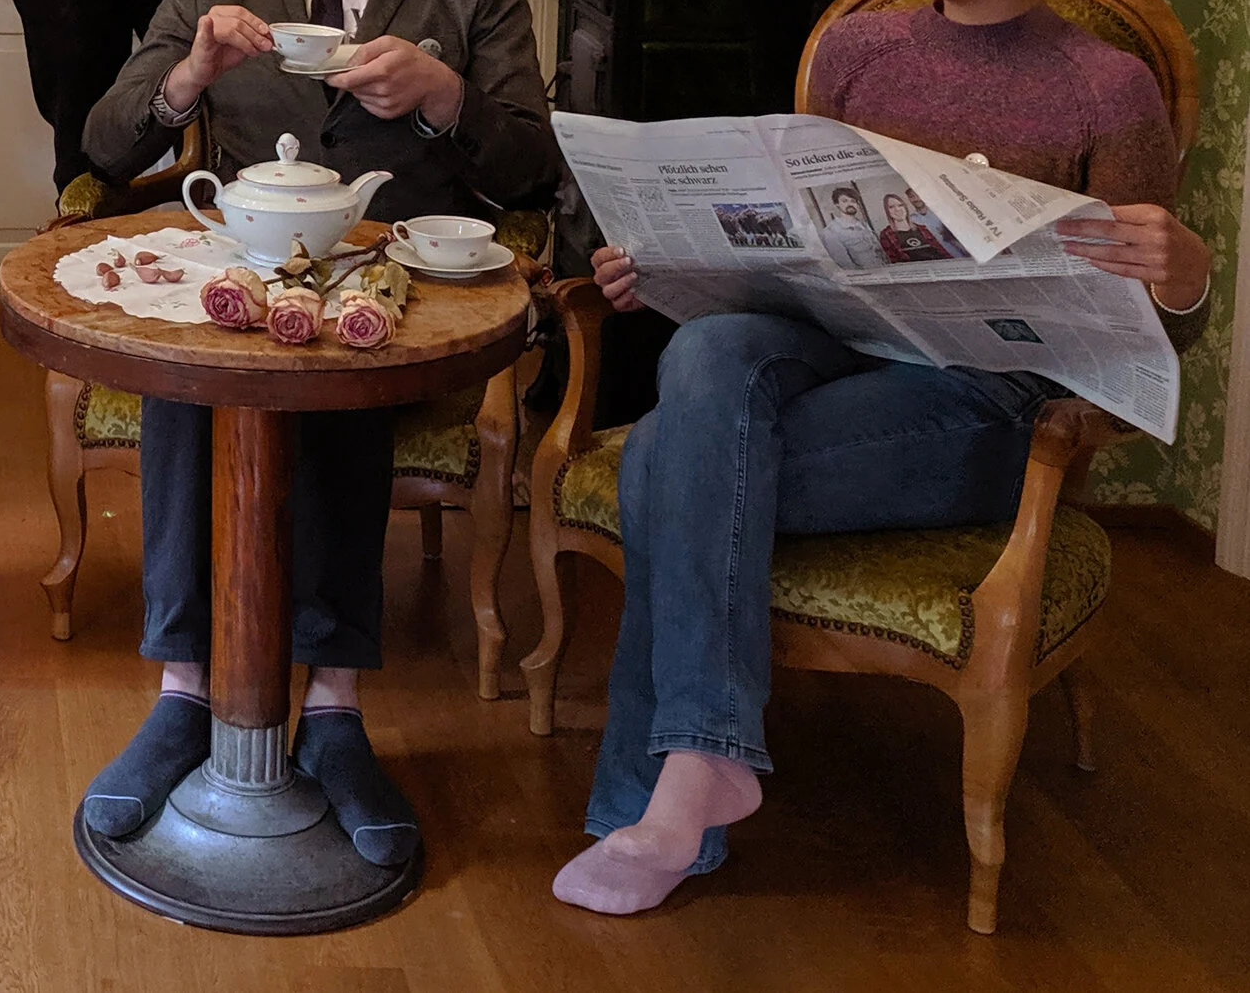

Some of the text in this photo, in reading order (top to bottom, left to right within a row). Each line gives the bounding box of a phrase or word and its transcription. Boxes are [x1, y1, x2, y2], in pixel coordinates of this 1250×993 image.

[785, 158, 801, 168] So
[802, 154, 835, 165] ticken
[836, 150, 854, 161] die
[658, 164, 728, 175] Plötzlich sehen
[664, 176, 677, 185] sie
[678, 176, 717, 185] schwarz
[966, 199, 986, 222] Radio
[989, 226, 1002, 238] TV
